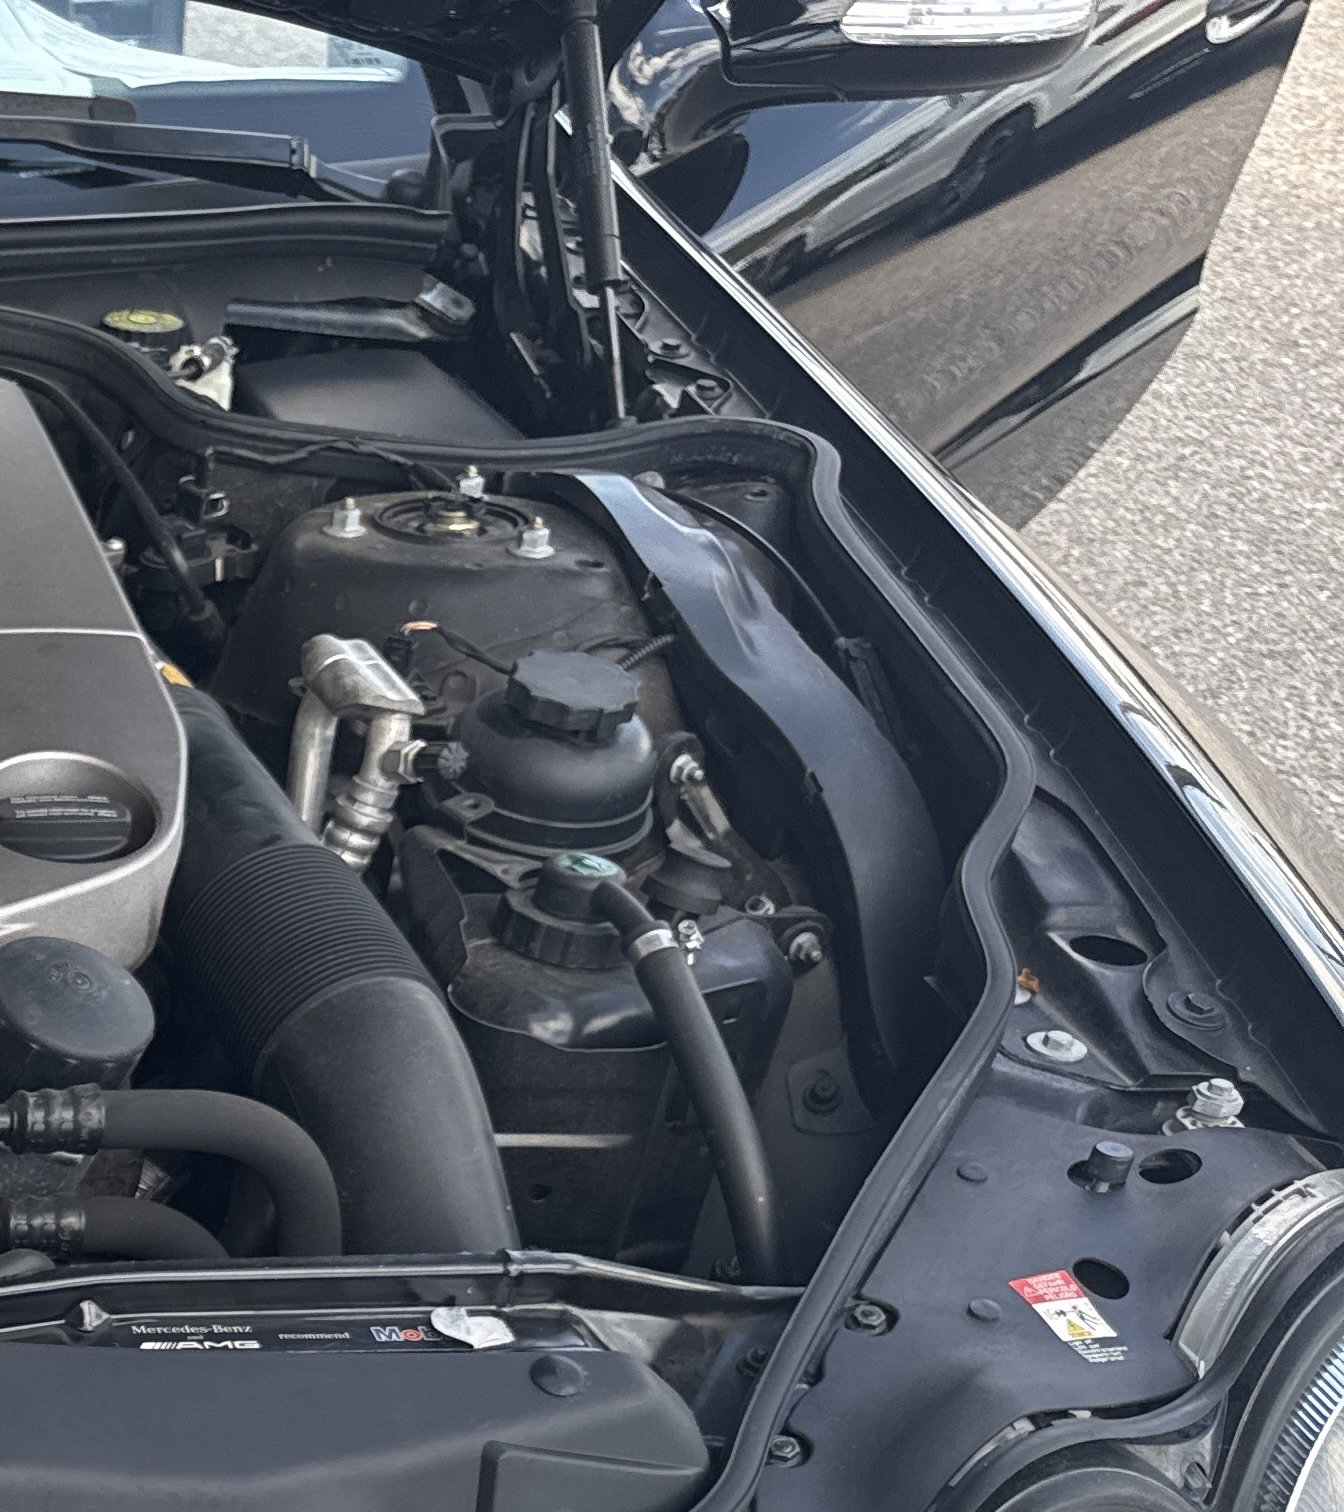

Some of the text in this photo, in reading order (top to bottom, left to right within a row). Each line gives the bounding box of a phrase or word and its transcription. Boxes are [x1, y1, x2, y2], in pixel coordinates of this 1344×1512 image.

[131, 1324, 254, 1335] Mercedes-Benz
[277, 1325, 443, 1342] recommend Mob
[175, 1340, 261, 1350] AMG
